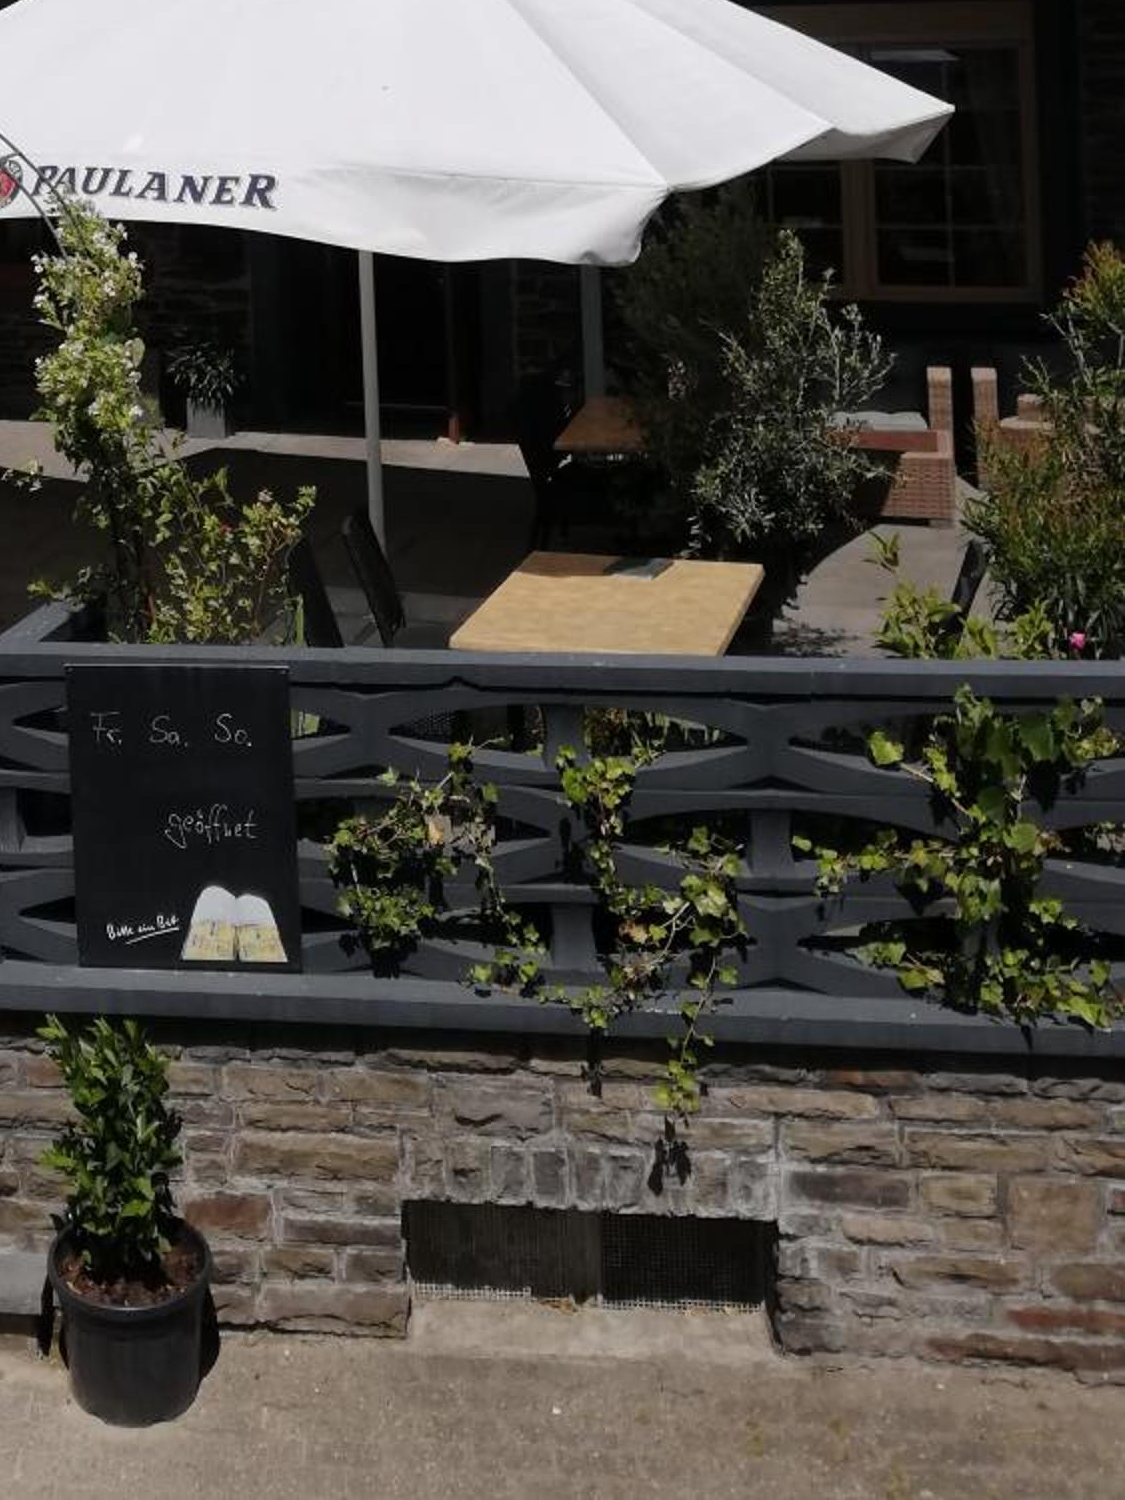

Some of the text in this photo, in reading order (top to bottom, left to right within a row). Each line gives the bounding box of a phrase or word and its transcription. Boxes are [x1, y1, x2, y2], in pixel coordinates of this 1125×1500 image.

[31, 164, 280, 210] PAULANER
[214, 713, 252, 747] So.
[164, 803, 257, 849] geöffnet
